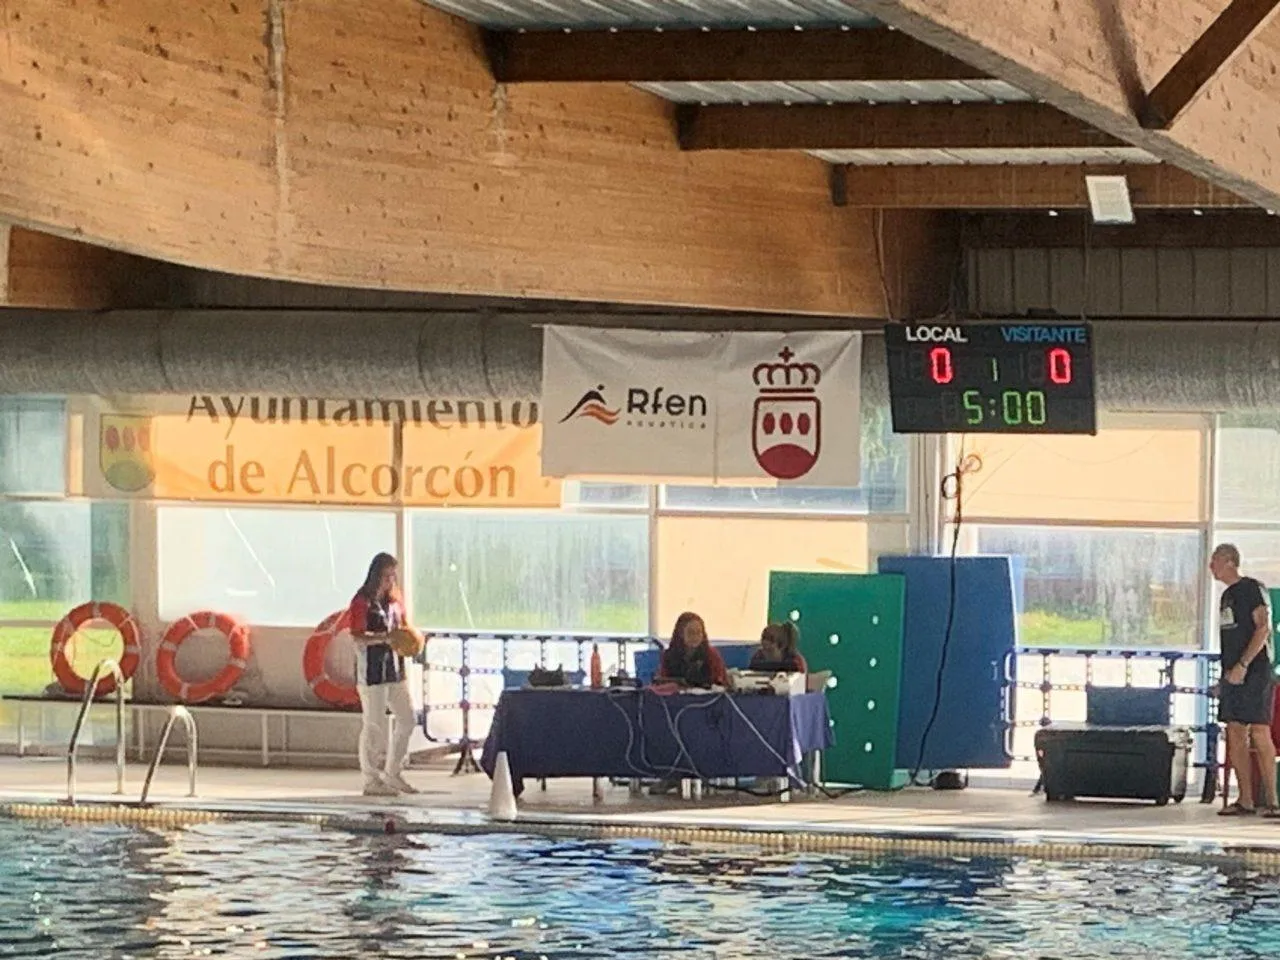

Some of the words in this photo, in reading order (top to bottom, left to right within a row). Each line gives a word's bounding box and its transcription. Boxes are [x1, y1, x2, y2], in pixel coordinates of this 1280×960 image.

[905, 326, 968, 343] LOCAL
[1000, 327, 1087, 343] VISITANTE
[930, 348, 953, 384] 0
[1049, 348, 1072, 384] 0
[186, 395, 540, 440] Ayuntamiento
[627, 387, 707, 416] Rfen
[962, 391, 1046, 425] 5:00
[206, 444, 265, 496] de
[287, 445, 516, 499] Alcorcón
